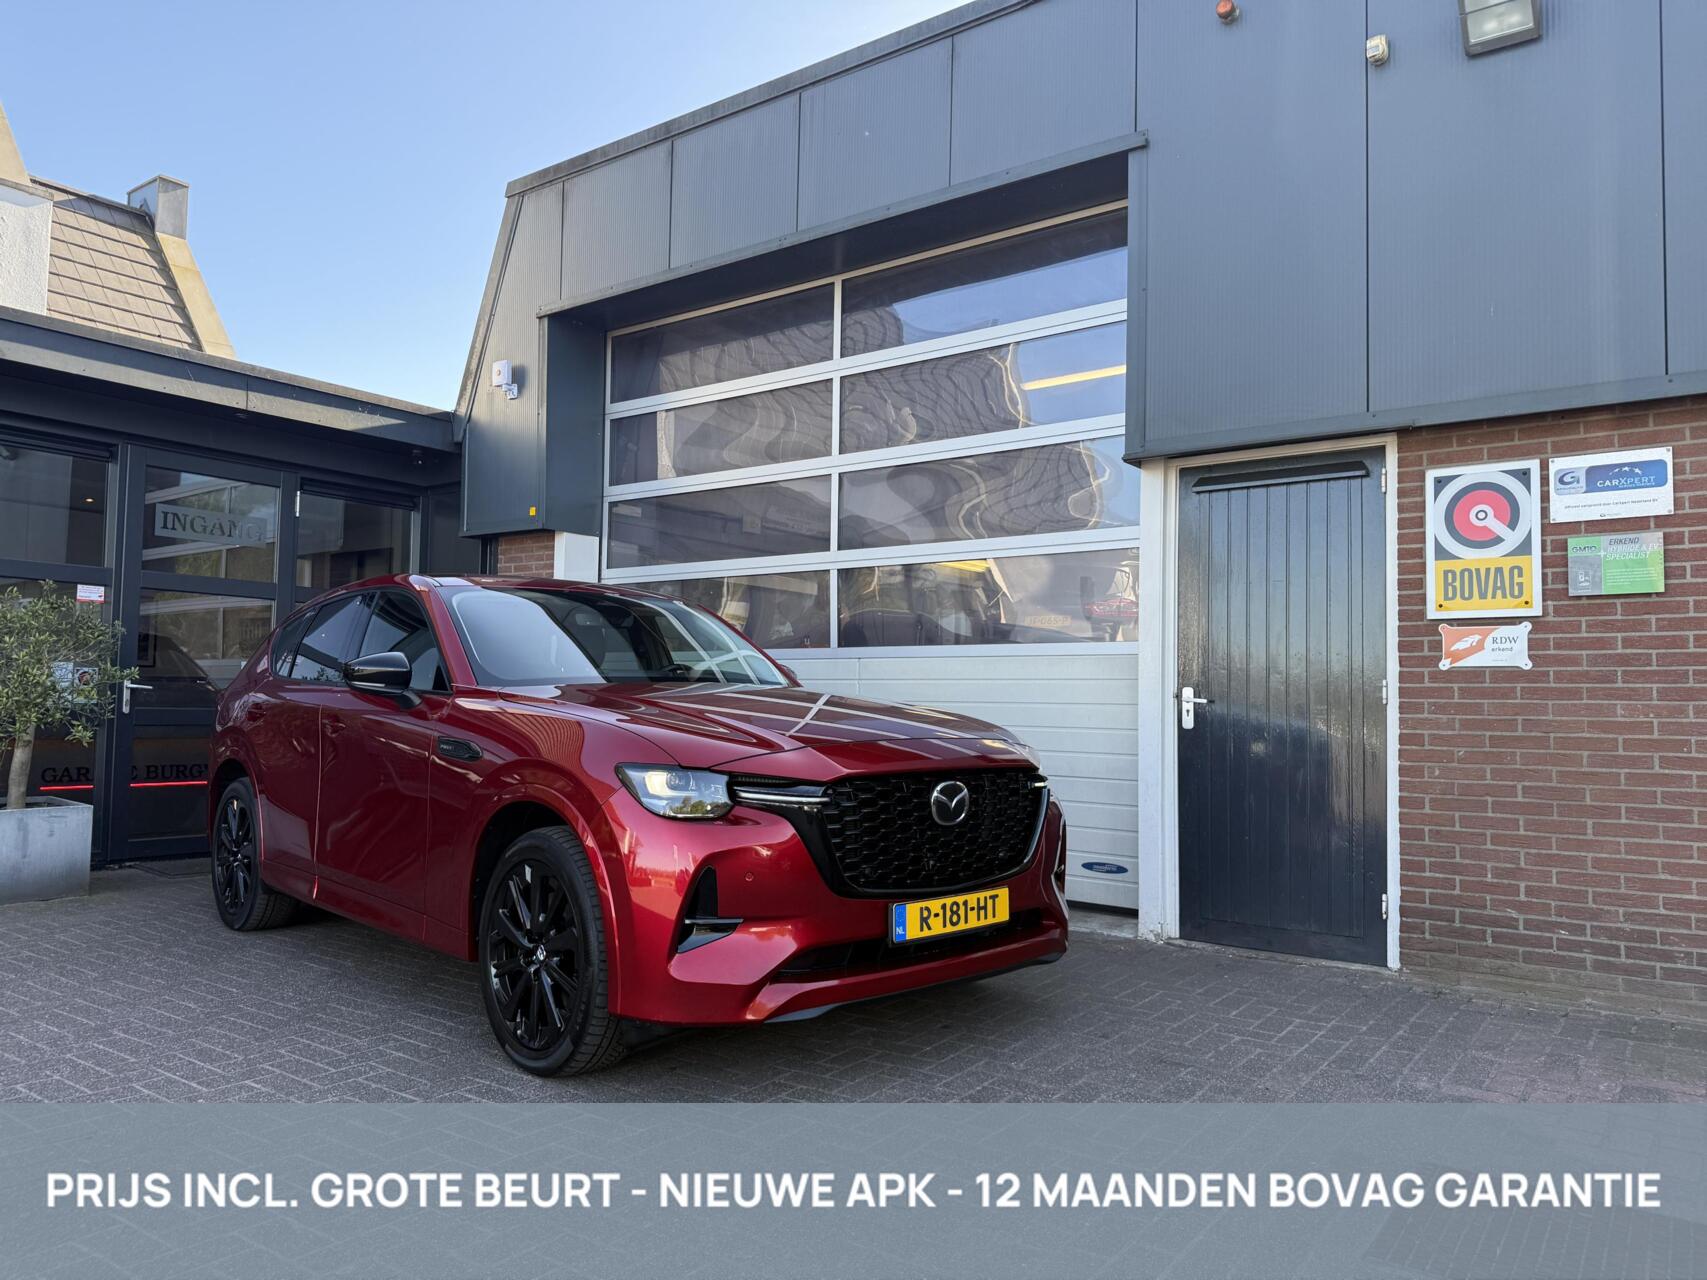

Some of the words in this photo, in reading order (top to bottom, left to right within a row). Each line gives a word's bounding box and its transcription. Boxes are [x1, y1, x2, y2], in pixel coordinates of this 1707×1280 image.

[1597, 476, 1656, 488] CARXPERT
[161, 510, 263, 541] INGANG
[1609, 536, 1640, 546] ERKEND
[1606, 550, 1650, 561] SPECIALIST
[1443, 565, 1524, 601] BOVAG
[1491, 636, 1519, 645] RDW
[146, 763, 208, 780] BURG
[920, 893, 999, 932] R-181-HT
[896, 926, 905, 935] NL
